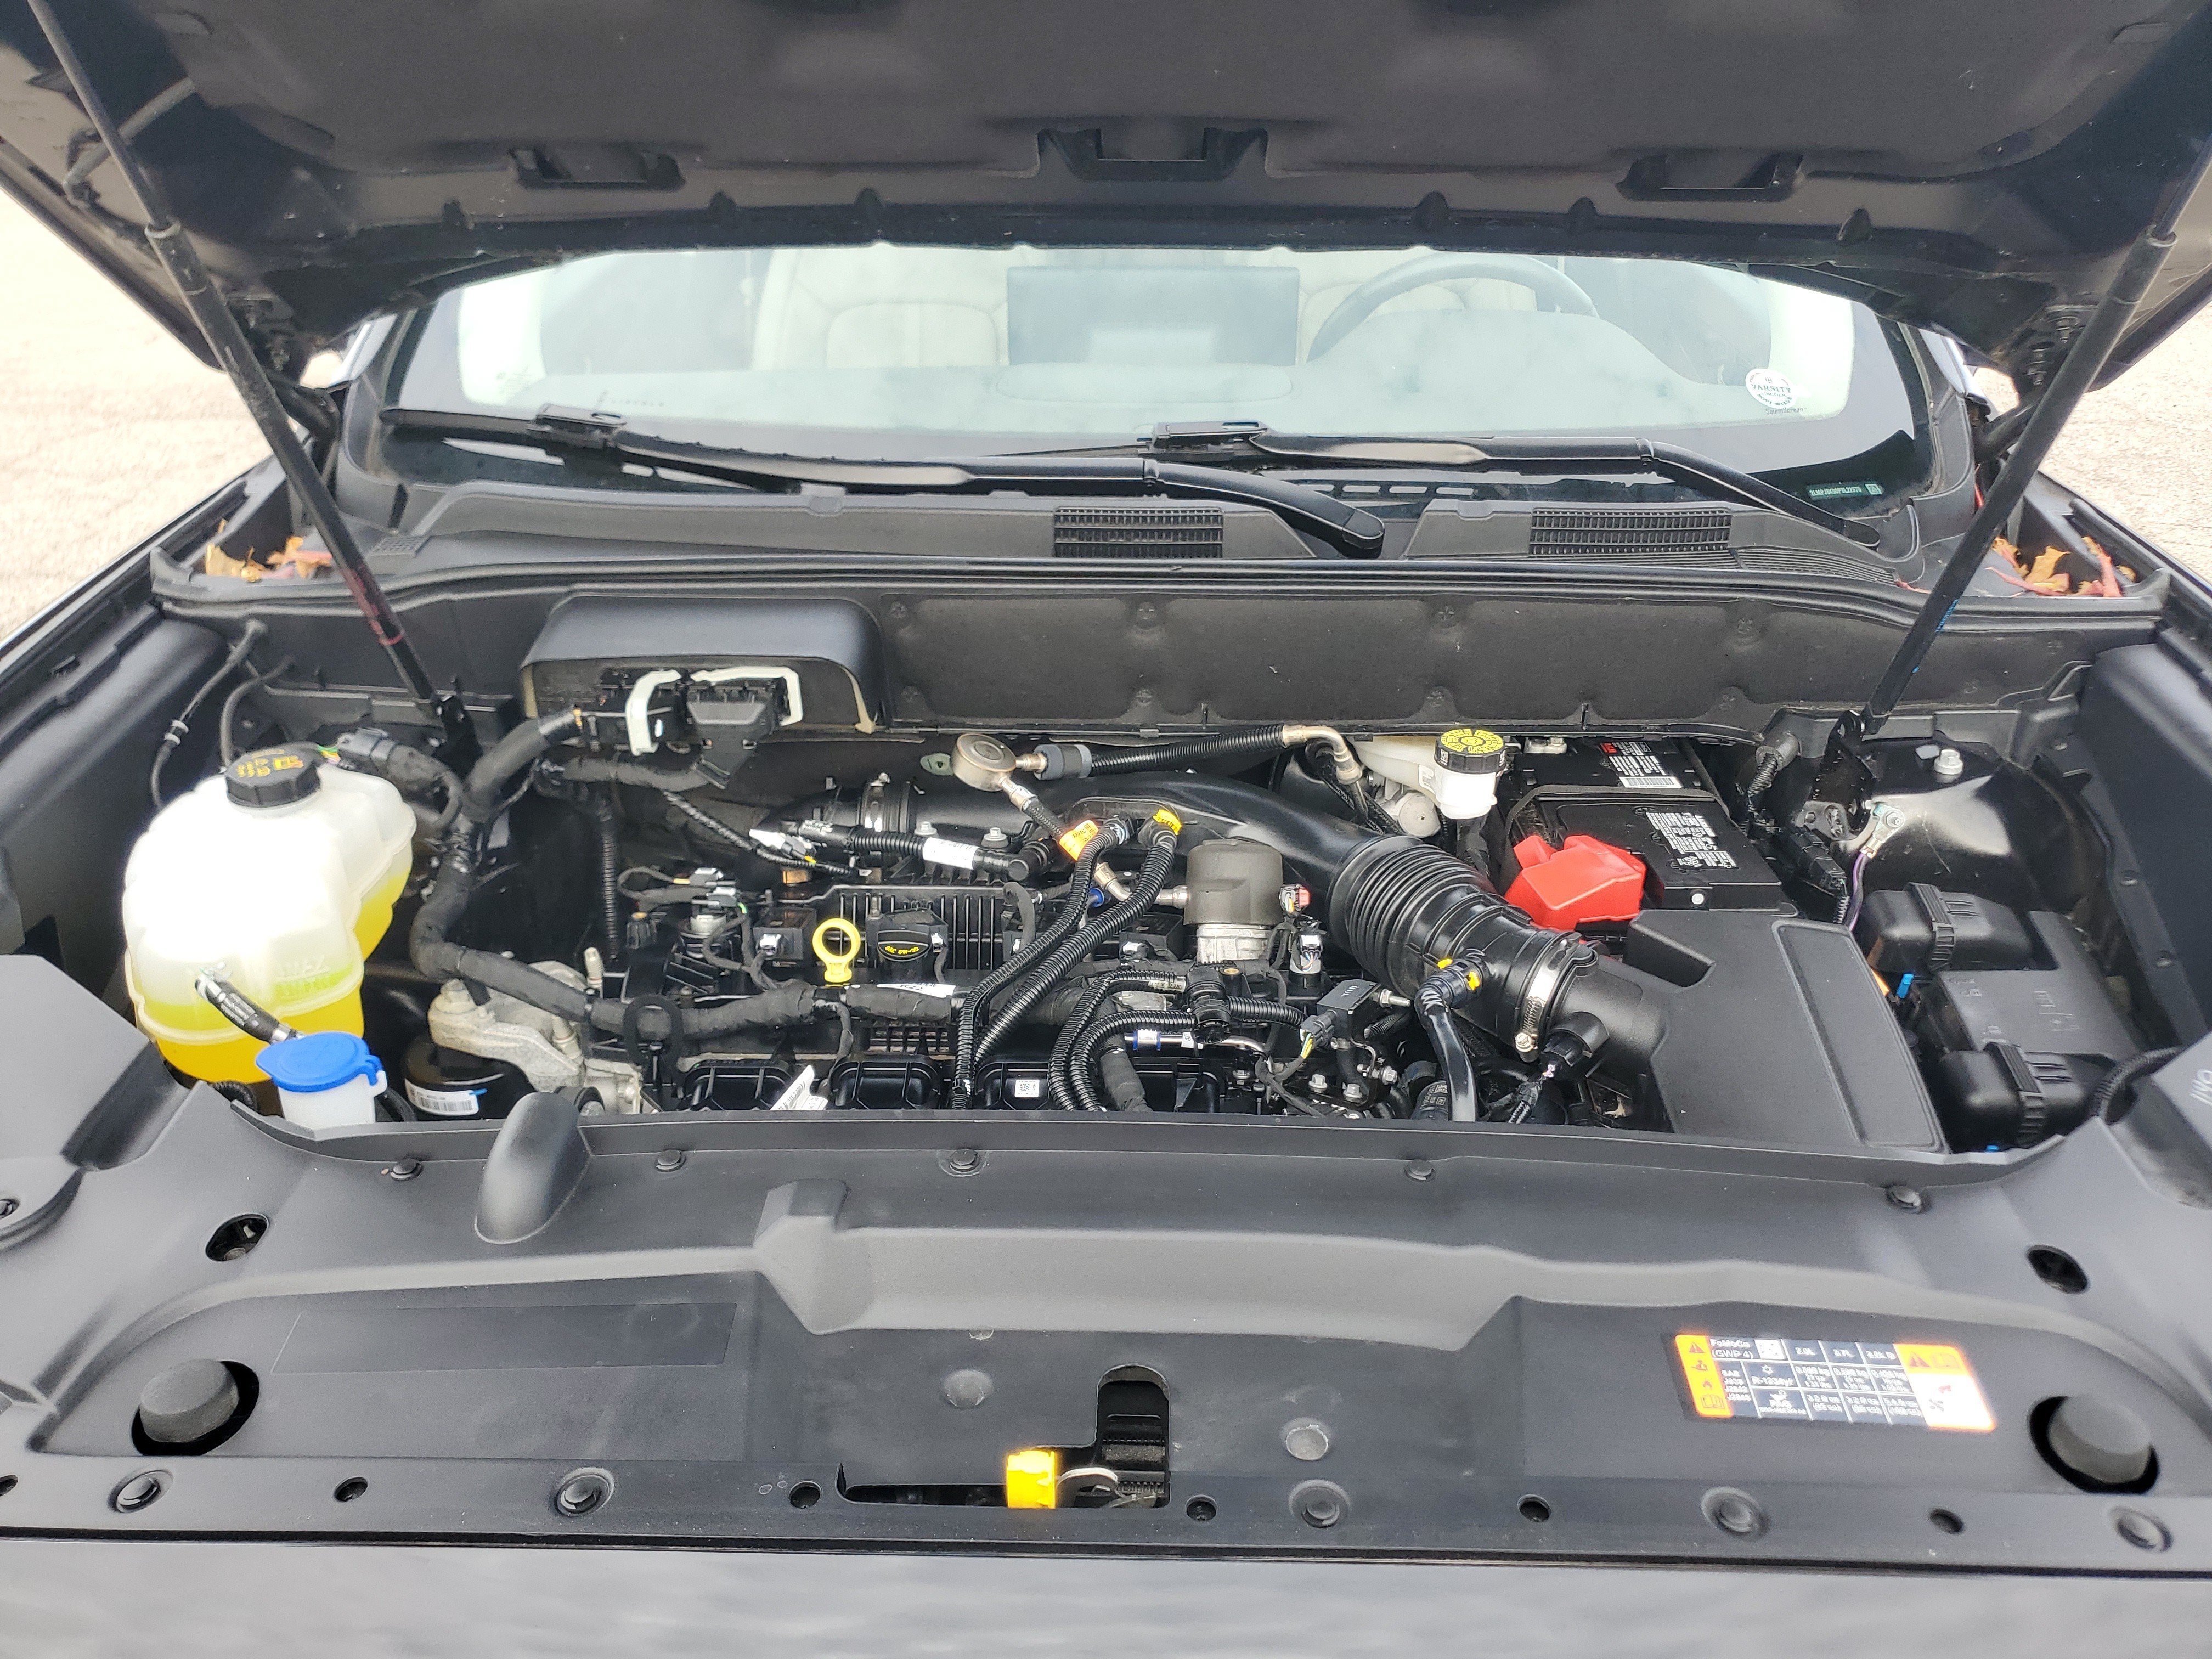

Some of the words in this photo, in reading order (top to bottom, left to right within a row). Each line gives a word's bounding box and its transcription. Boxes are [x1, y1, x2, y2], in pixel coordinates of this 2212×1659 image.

[1751, 383, 1791, 393] VARSITY
[1709, 1339, 1751, 1348] FoMoCo
[1711, 1348, 1740, 1358] (GWP
[1742, 1350, 1754, 1359] 4)
